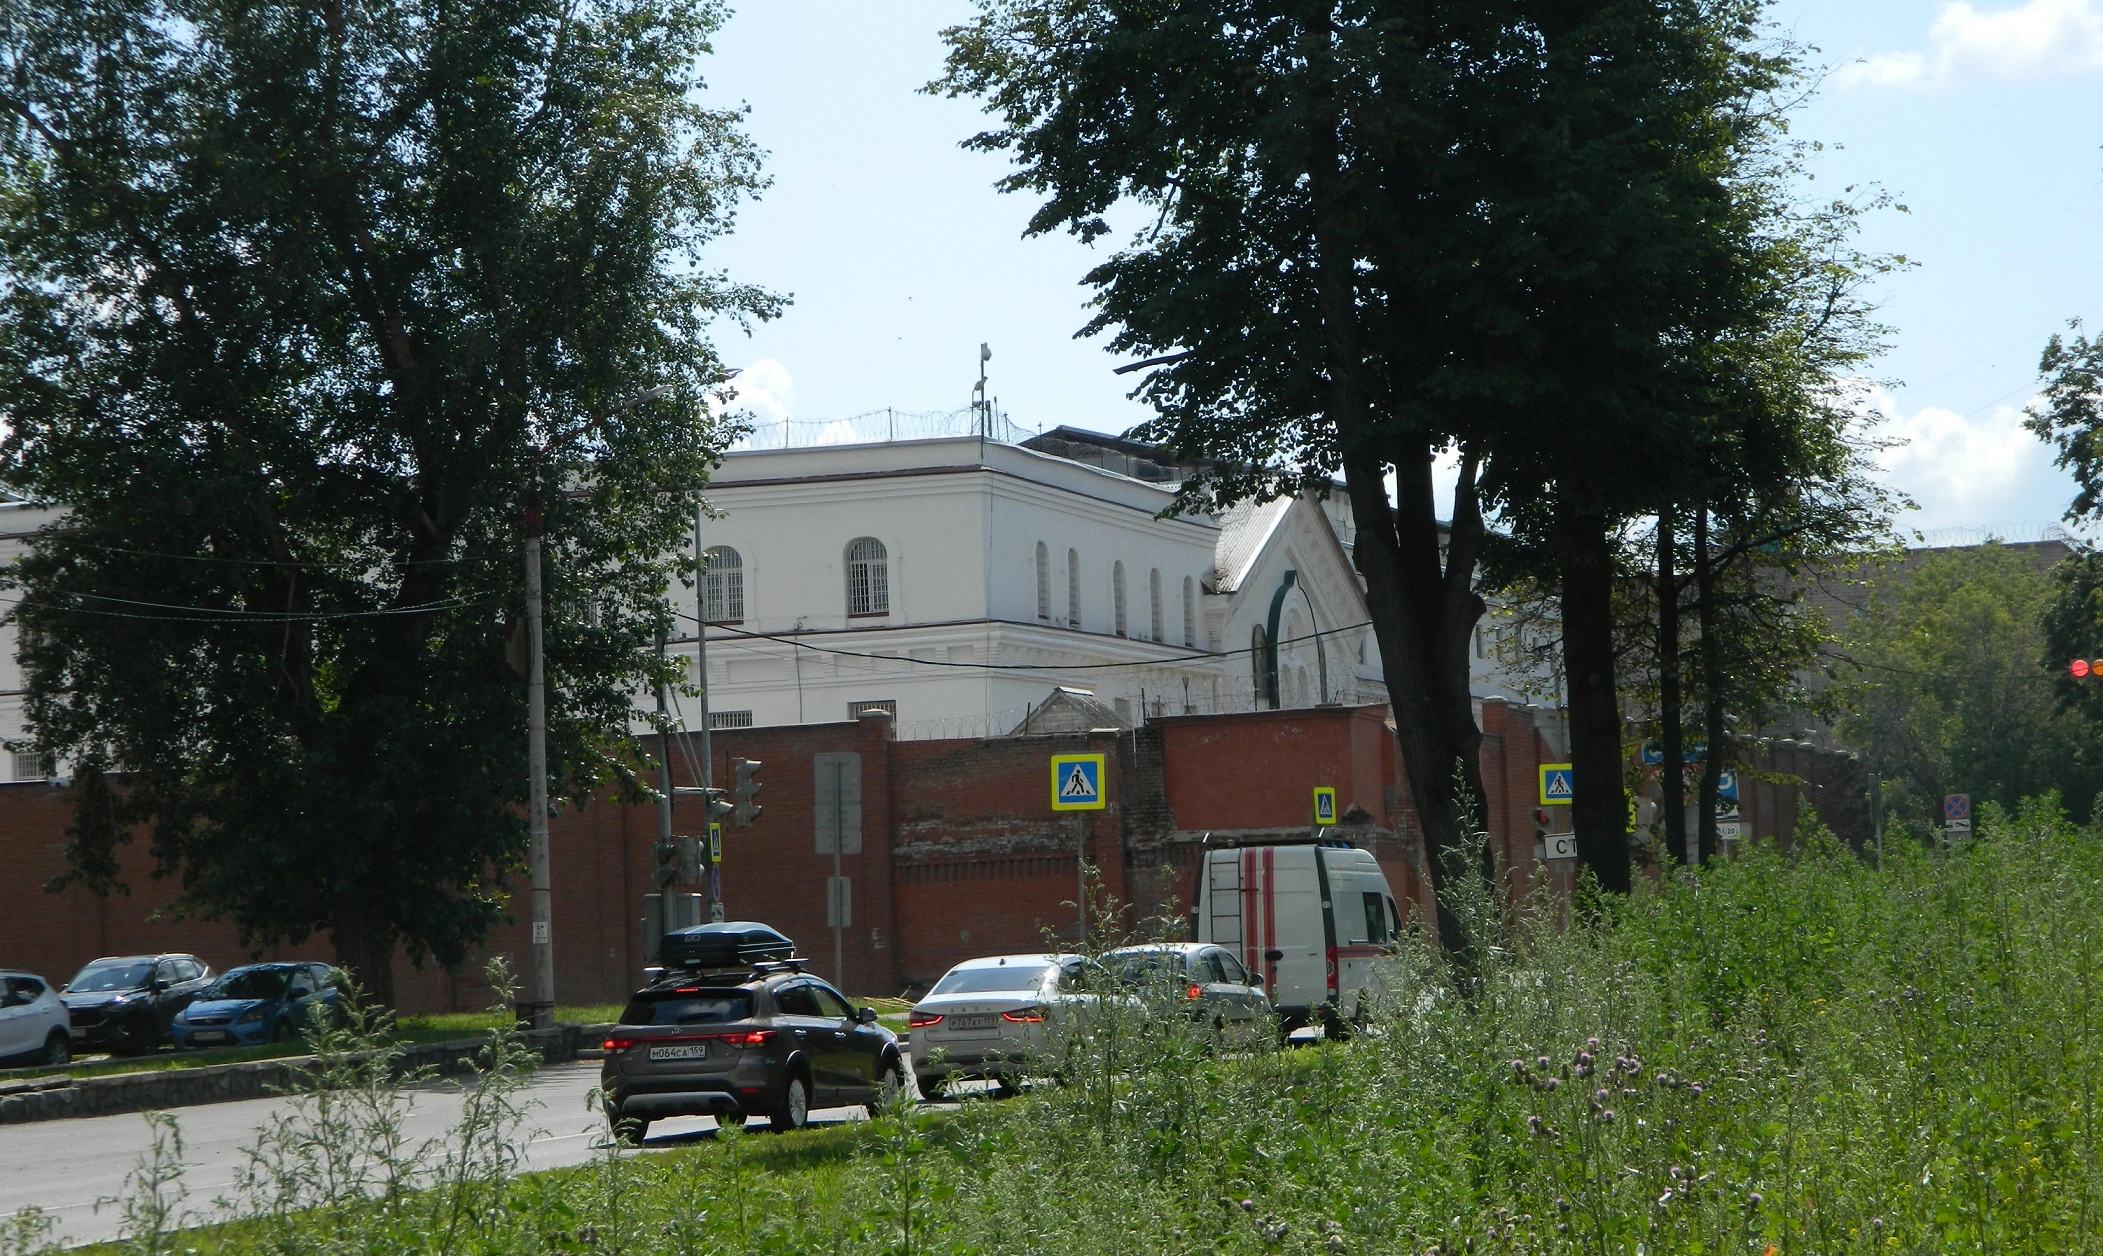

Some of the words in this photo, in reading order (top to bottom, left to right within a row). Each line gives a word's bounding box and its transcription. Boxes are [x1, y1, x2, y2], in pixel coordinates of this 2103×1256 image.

[1556, 838, 1577, 854] СТ
[652, 1048, 688, 1058] М064СА
[690, 1046, 704, 1054] 159
